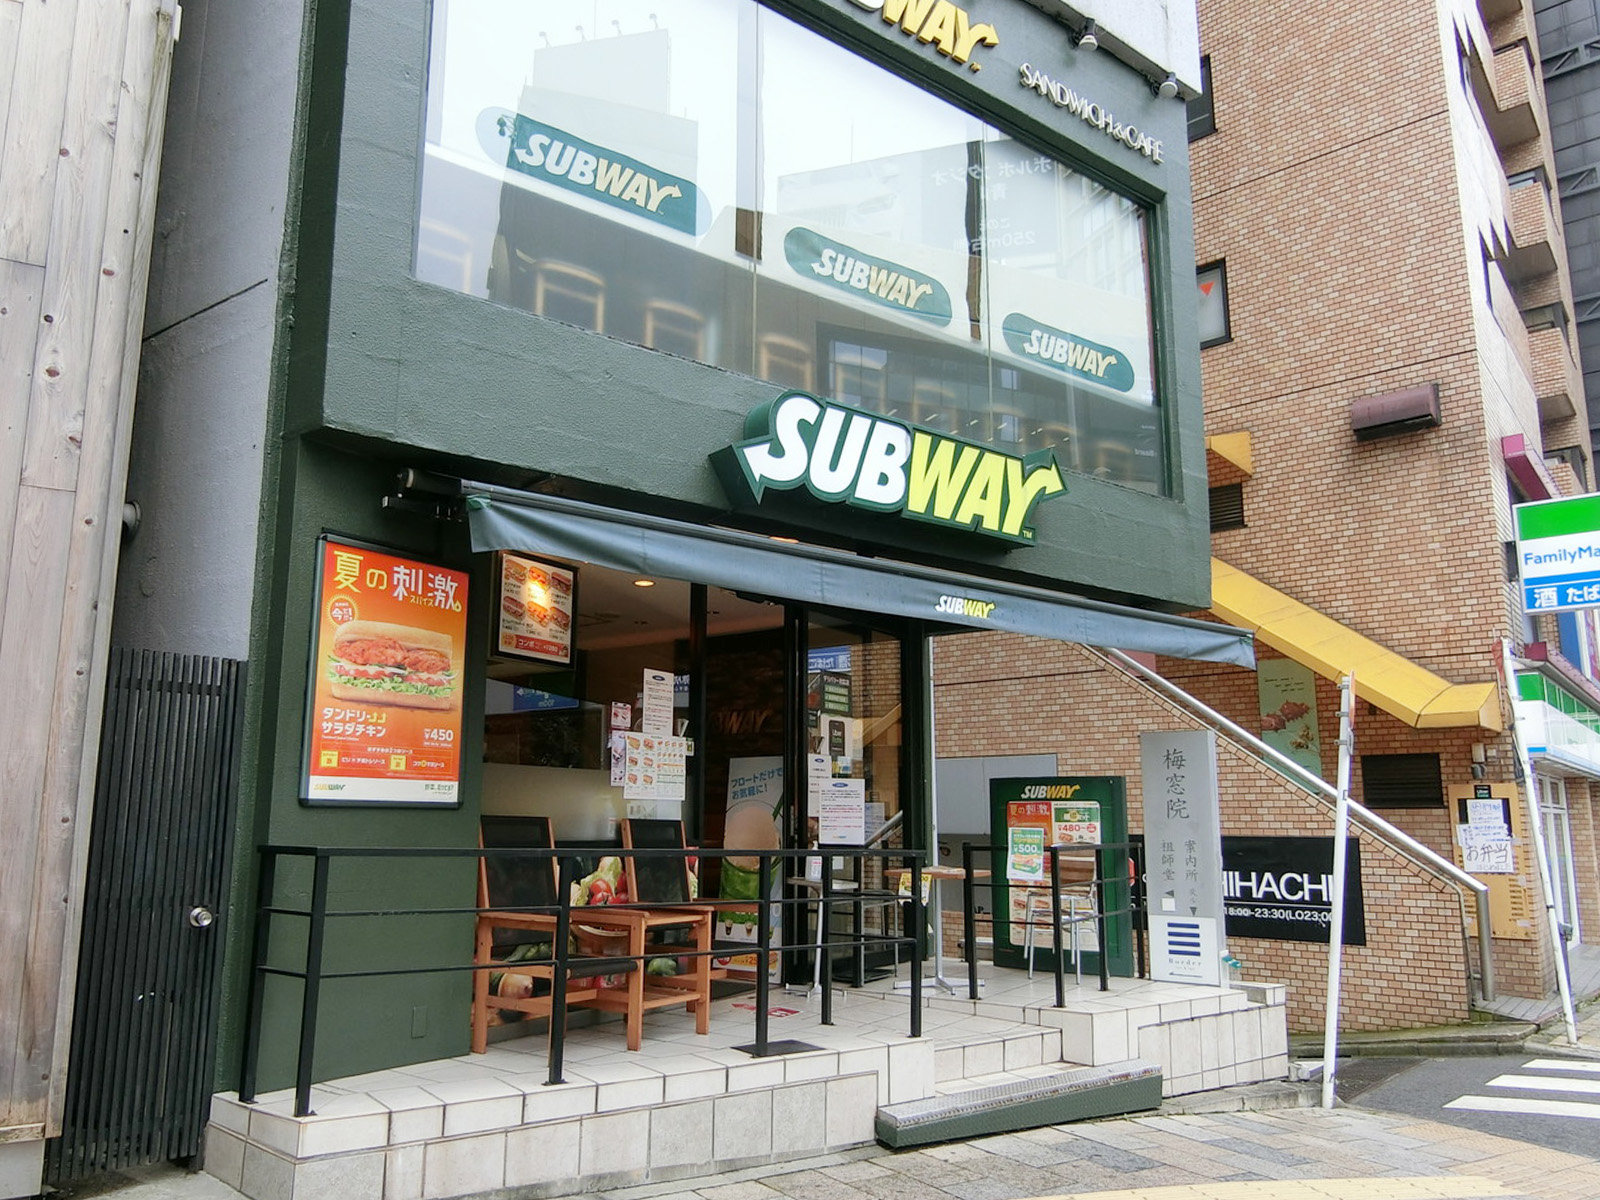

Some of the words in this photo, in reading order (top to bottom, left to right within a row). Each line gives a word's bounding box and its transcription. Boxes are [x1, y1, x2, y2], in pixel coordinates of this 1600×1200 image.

[843, 0, 999, 65] WAY
[514, 133, 683, 213] SUBWAY
[811, 248, 934, 309] SUBWAY
[1022, 329, 1119, 378] SUBWAY
[743, 394, 1063, 536] SUBWAY
[935, 594, 996, 619] SUBWAY
[1533, 587, 1558, 608] 酒
[321, 721, 387, 738] サラダチキン
[1021, 784, 1081, 799] SUBWAY
[1163, 748, 1190, 820] 梅窓院
[1185, 840, 1198, 882] 案内所
[1466, 843, 1508, 864] お弁当
[1222, 870, 1334, 902] IHACHI
